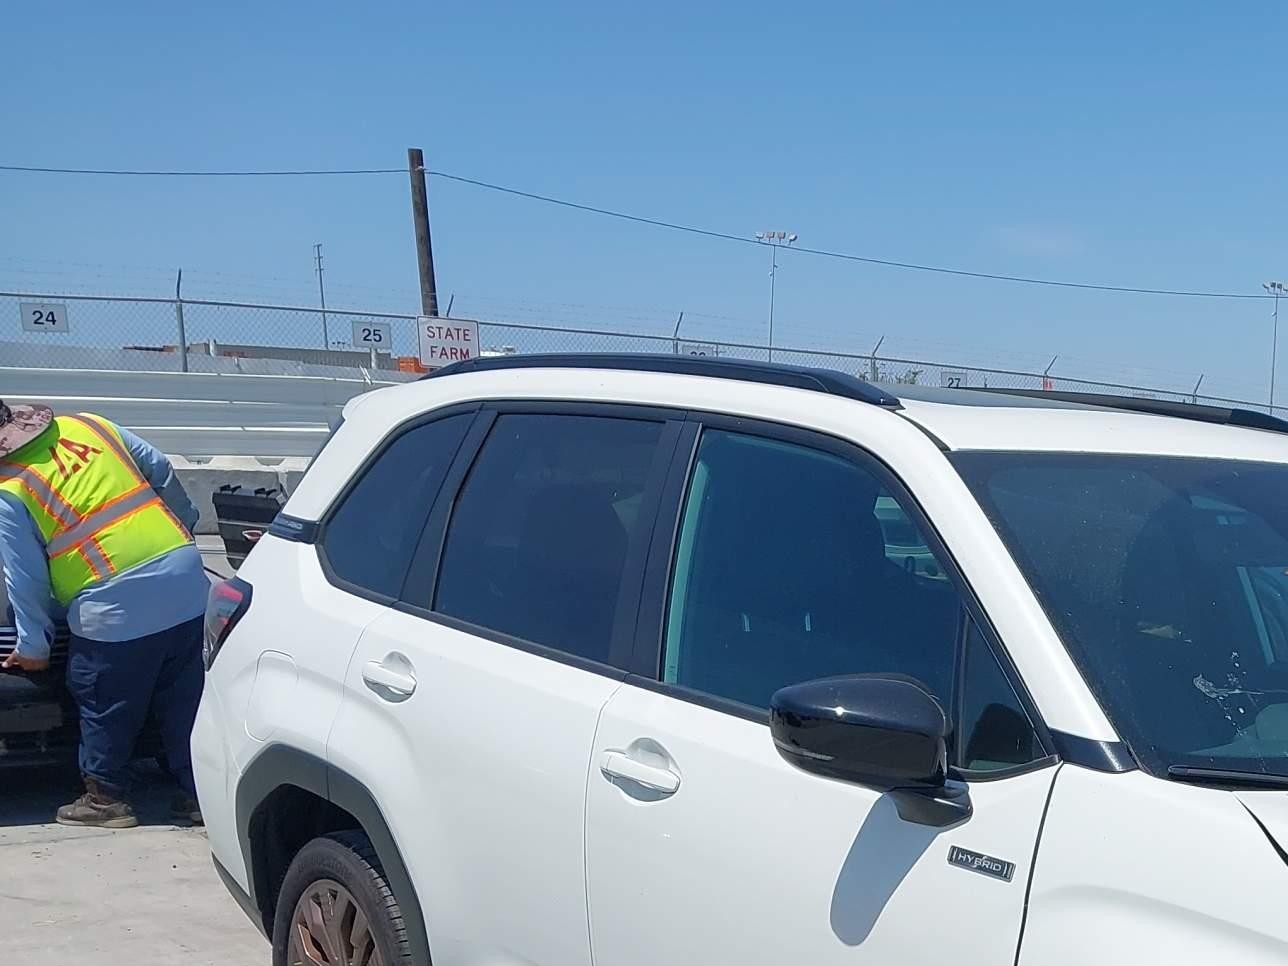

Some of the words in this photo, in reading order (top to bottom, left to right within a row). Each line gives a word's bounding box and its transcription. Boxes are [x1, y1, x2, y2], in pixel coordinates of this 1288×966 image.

[32, 310, 57, 325] 24
[361, 328, 382, 342] 25
[426, 326, 471, 341] STATE
[430, 345, 470, 360] FARM
[947, 377, 961, 389] 27
[957, 850, 1002, 872] HYBRID
